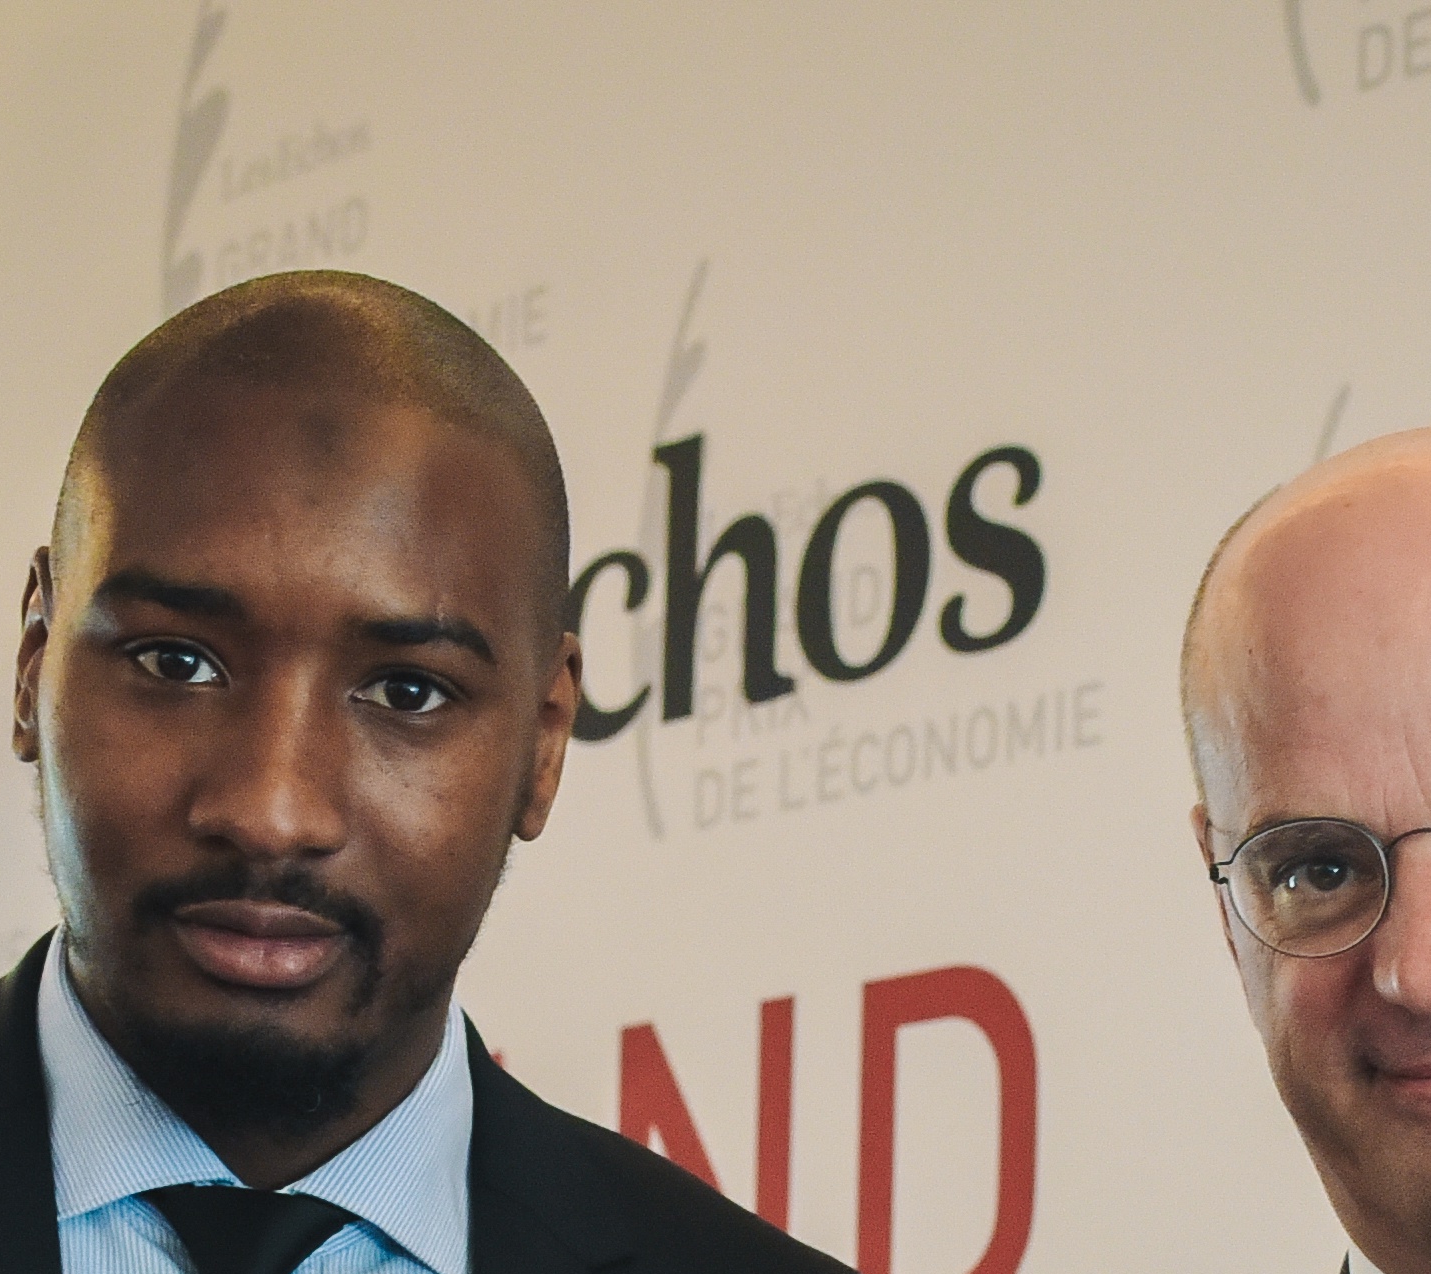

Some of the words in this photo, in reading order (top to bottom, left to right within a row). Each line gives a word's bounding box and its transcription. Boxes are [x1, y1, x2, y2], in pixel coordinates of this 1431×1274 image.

[569, 426, 1049, 746] chos
[691, 756, 762, 833] DE
[769, 678, 1107, 816] L'ÉCONOMIE
